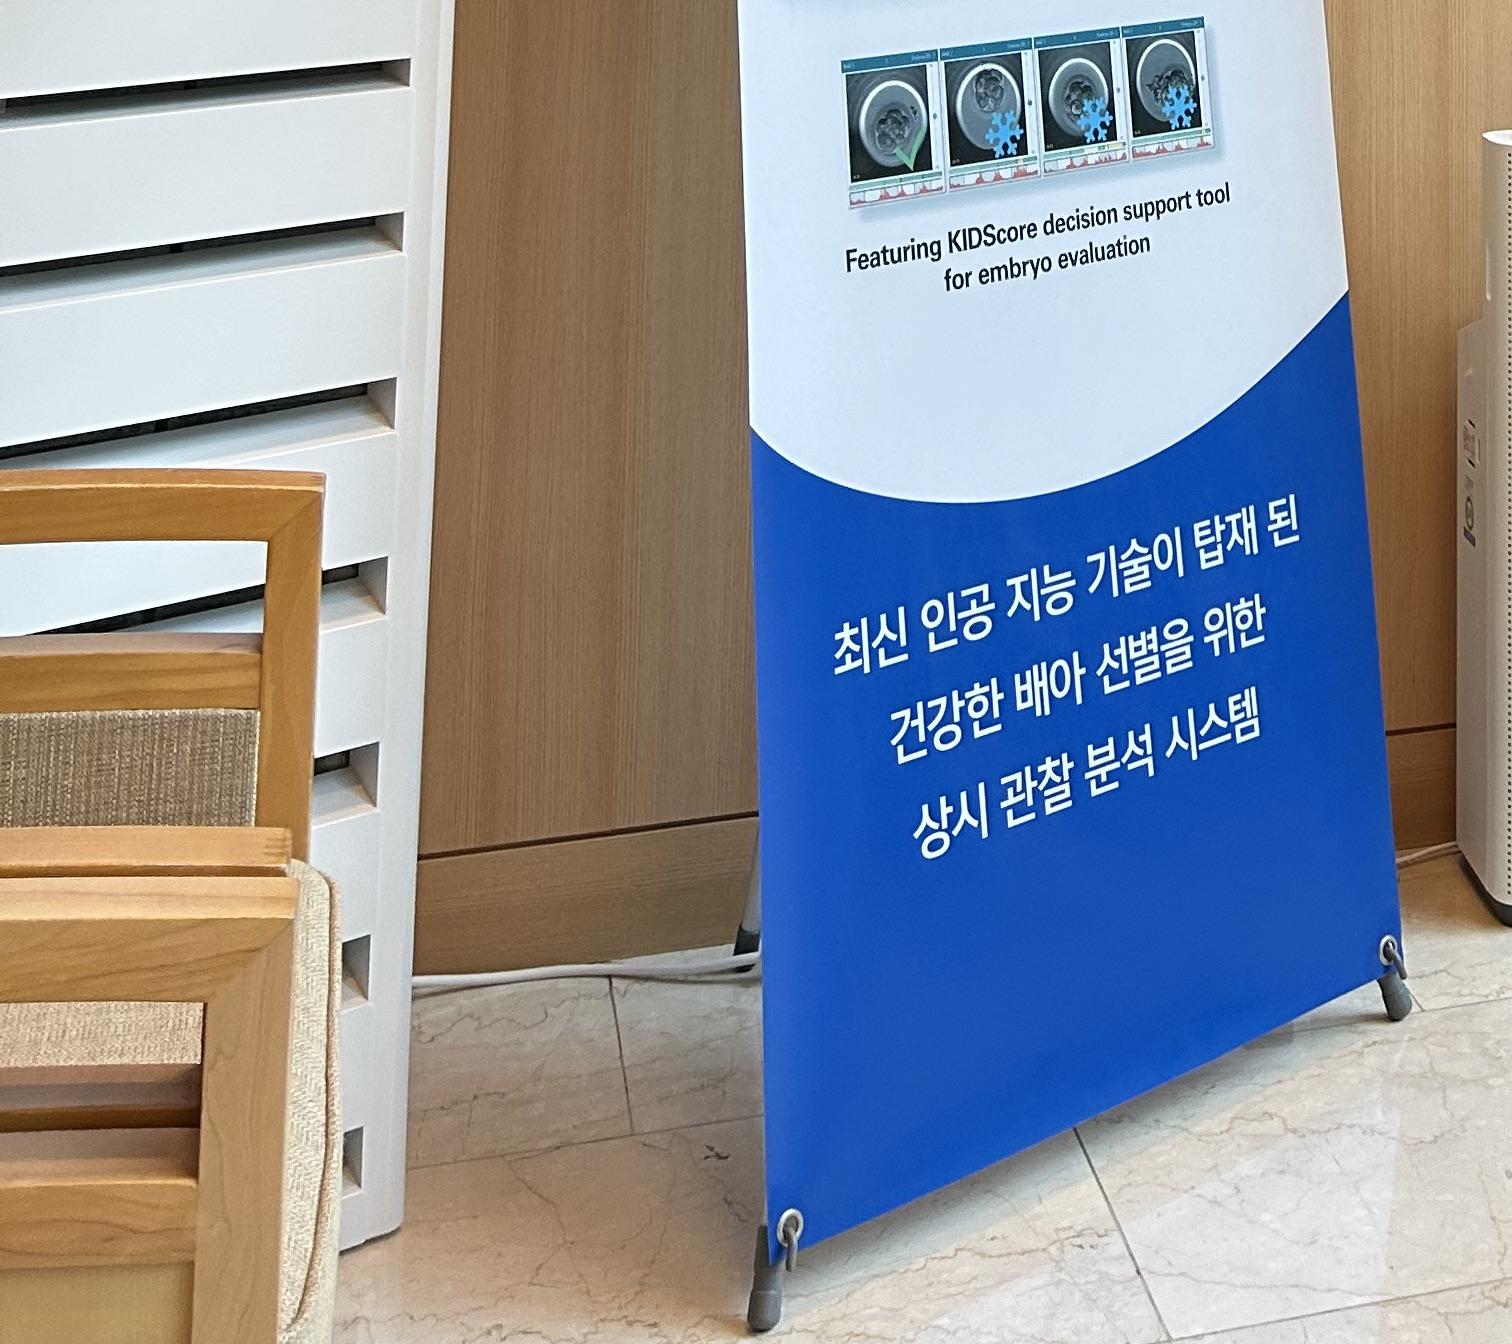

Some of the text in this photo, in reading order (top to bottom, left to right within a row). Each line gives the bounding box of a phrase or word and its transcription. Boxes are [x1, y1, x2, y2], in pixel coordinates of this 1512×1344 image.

[845, 182, 1231, 273] Featuring KIDScore decision support tool
[944, 234, 1151, 292] for embryo evaluation
[833, 494, 1300, 676] 최신 인공 지능 기술이 탑재 된
[890, 593, 1267, 765] 건강한 배아 선별을 위한
[912, 686, 1261, 861] 상시 관찰 분석 시스템
